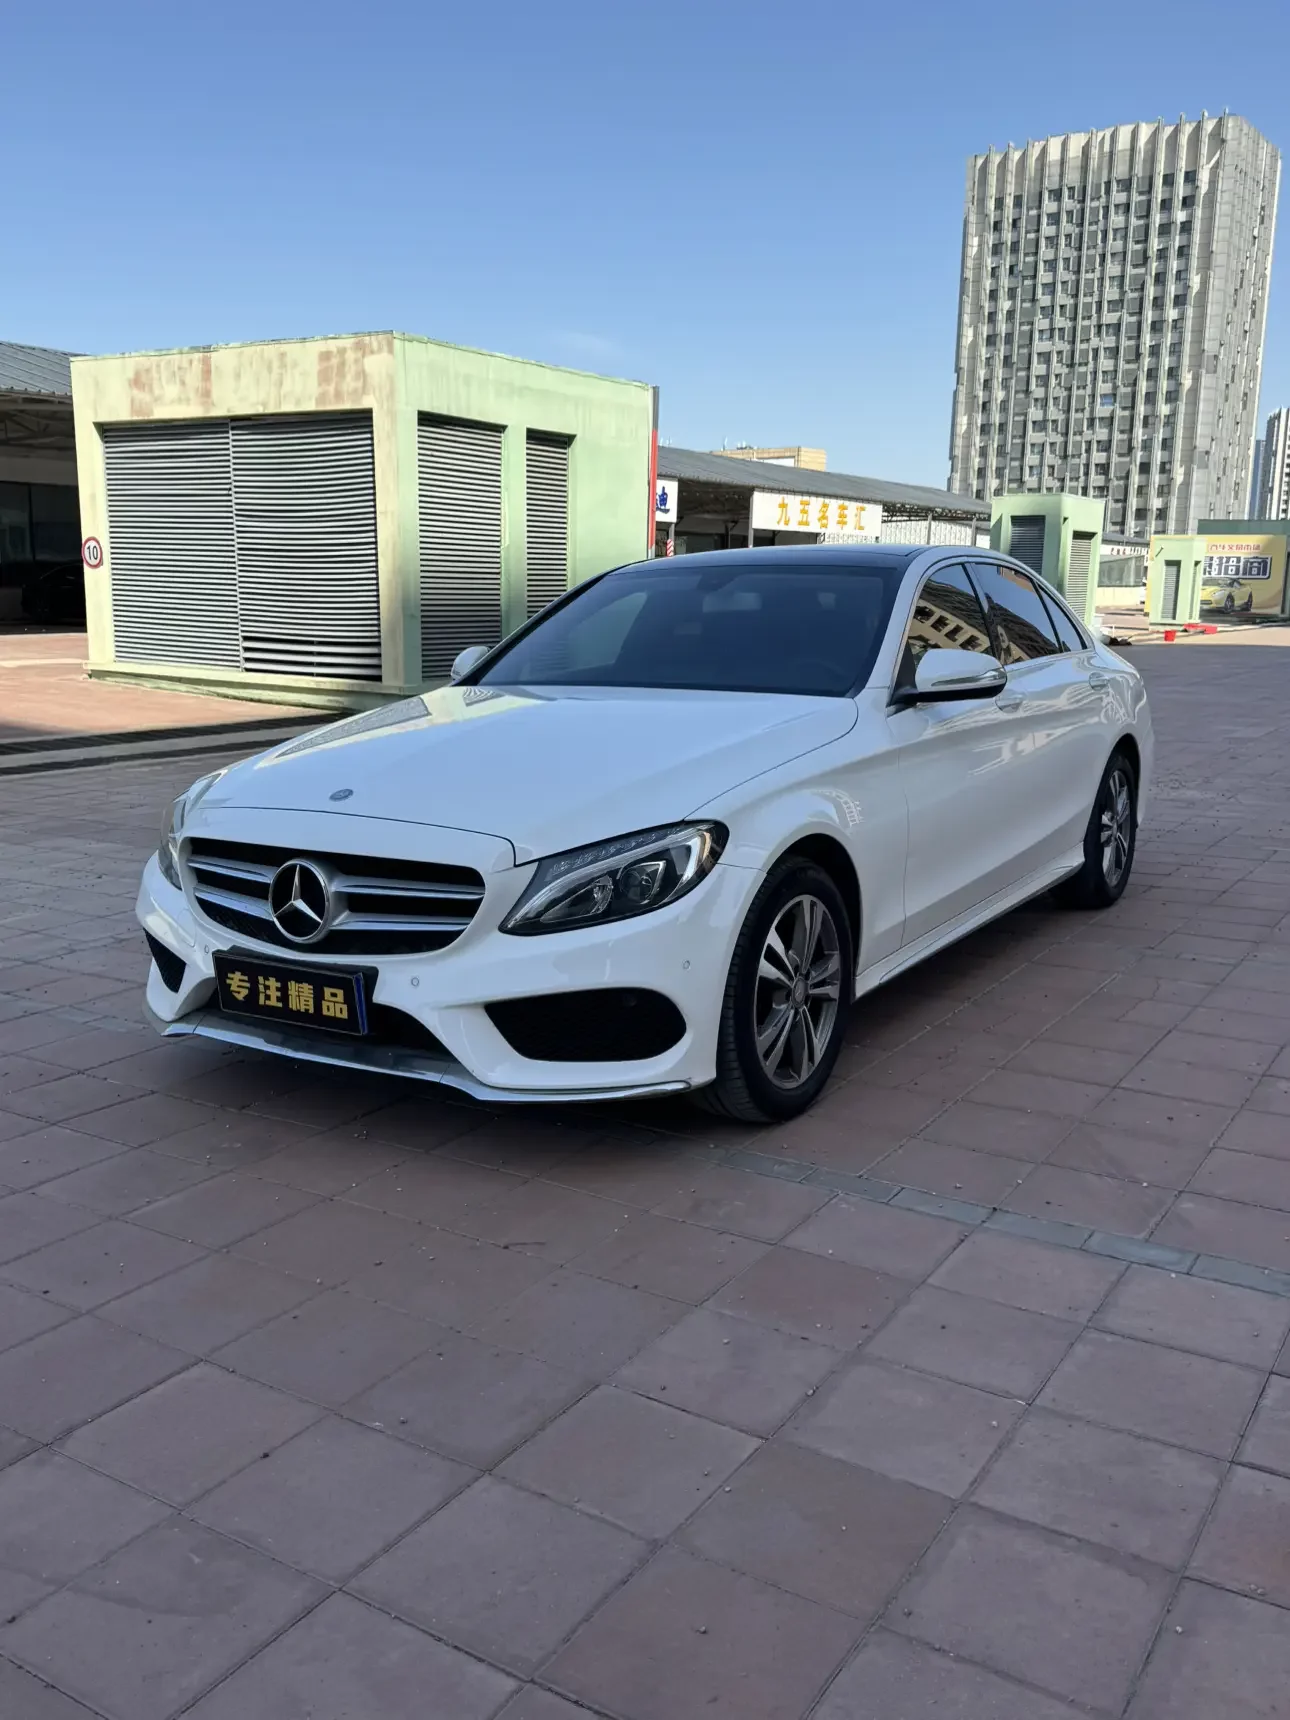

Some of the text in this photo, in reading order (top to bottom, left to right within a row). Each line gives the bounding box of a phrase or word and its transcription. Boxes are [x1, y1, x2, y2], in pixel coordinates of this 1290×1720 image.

[777, 496, 866, 531] 九五名车汇
[86, 545, 98, 560] 10
[226, 971, 348, 1019] 专注精品
